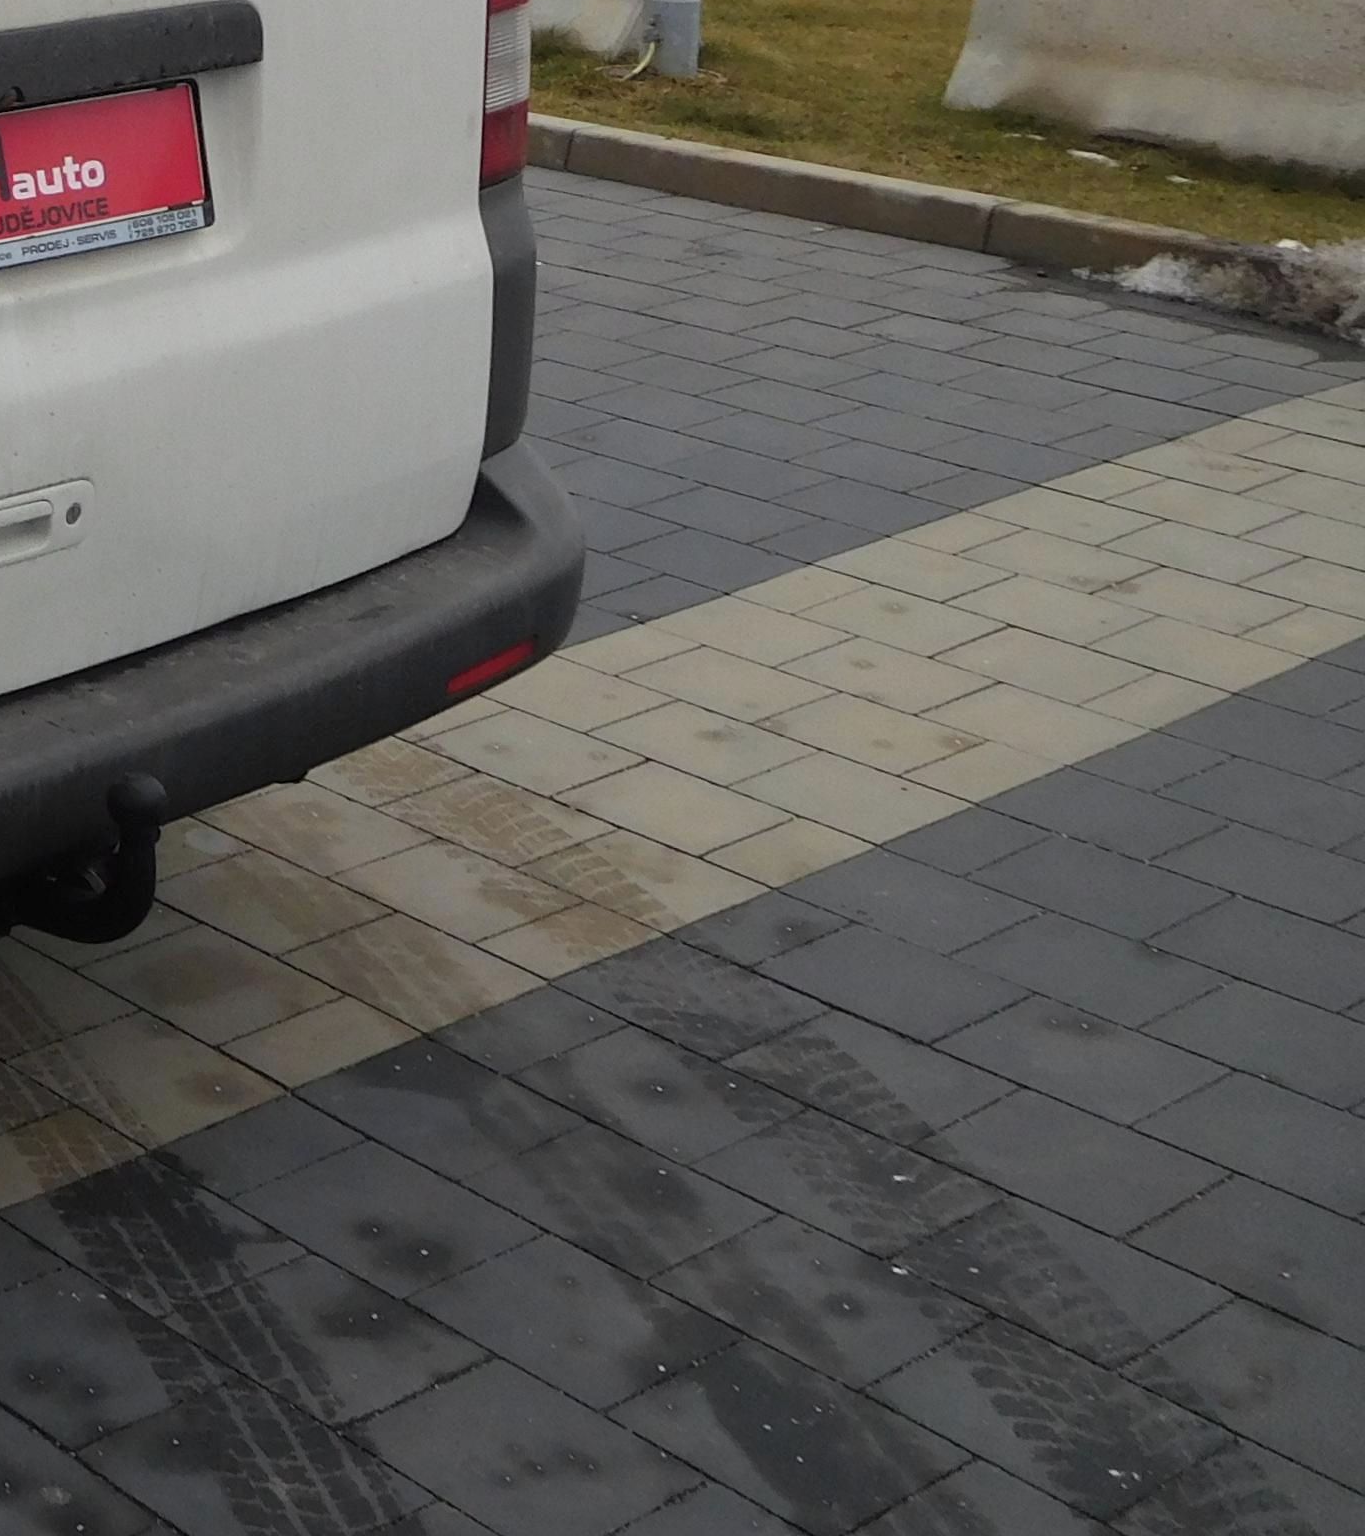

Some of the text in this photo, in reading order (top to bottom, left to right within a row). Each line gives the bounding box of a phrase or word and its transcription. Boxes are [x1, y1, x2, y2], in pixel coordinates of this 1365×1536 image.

[11, 155, 106, 201] auto
[21, 238, 70, 257] PRODEJ
[76, 228, 118, 246] SERVIS
